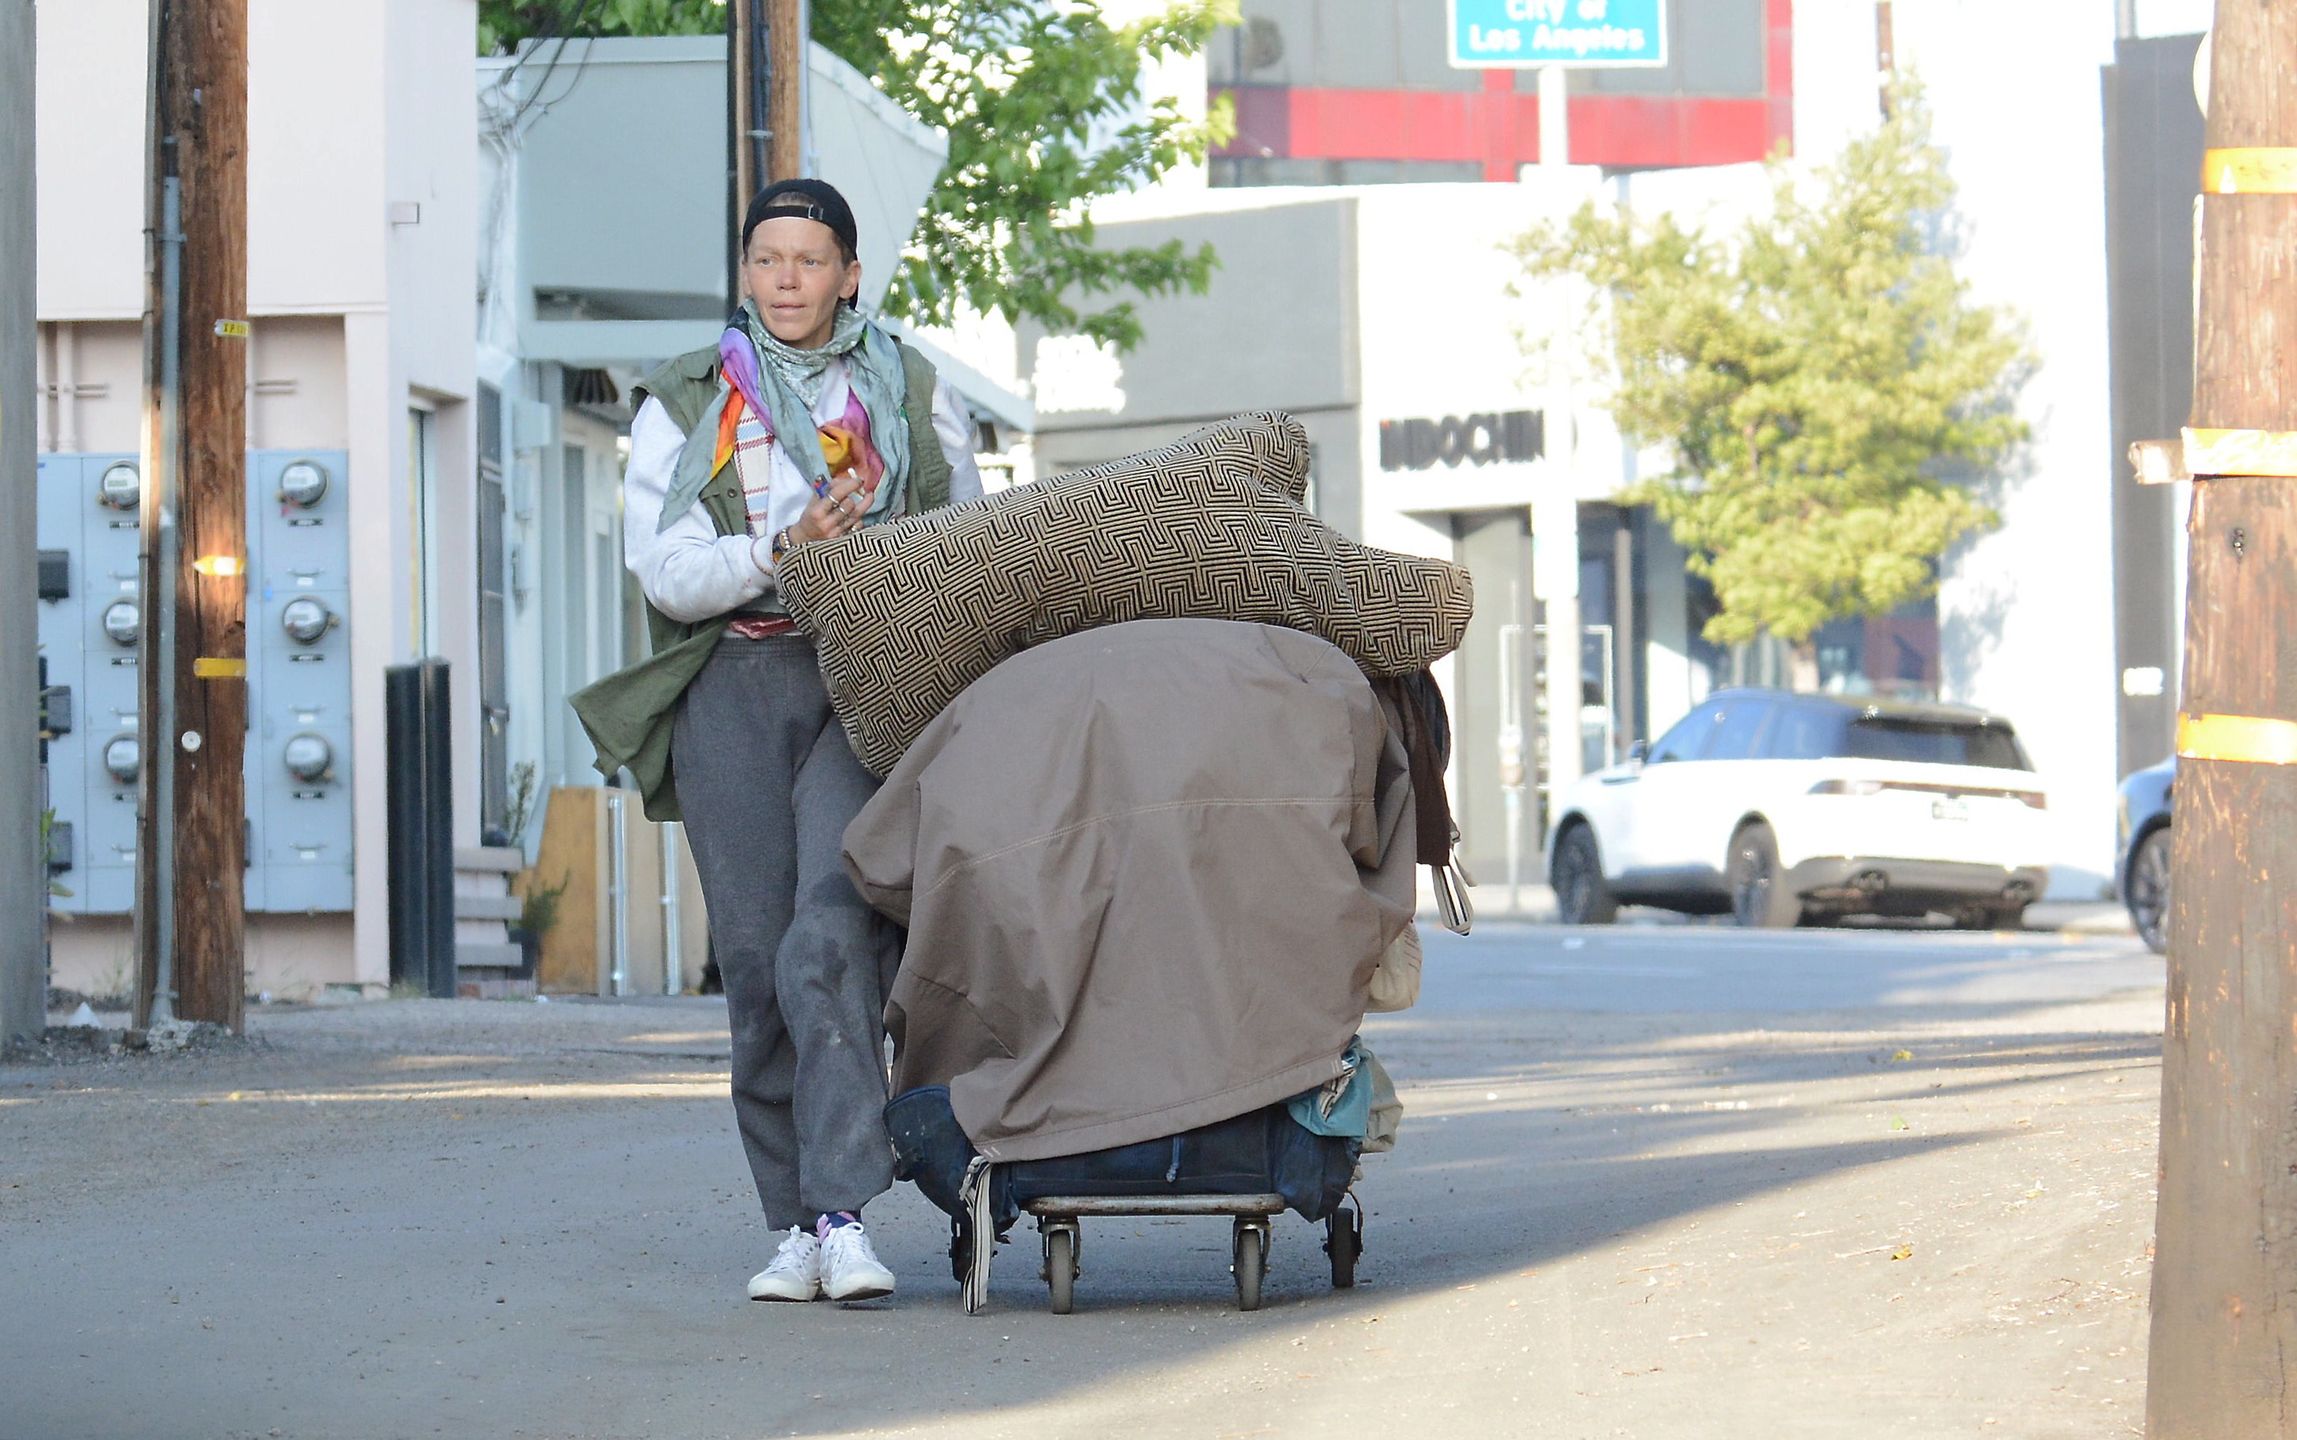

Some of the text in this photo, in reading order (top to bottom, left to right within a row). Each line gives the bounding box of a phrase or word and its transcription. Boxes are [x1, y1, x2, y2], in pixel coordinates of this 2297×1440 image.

[1506, 0, 1606, 23] City of
[1470, 24, 1645, 55] Los Angeles
